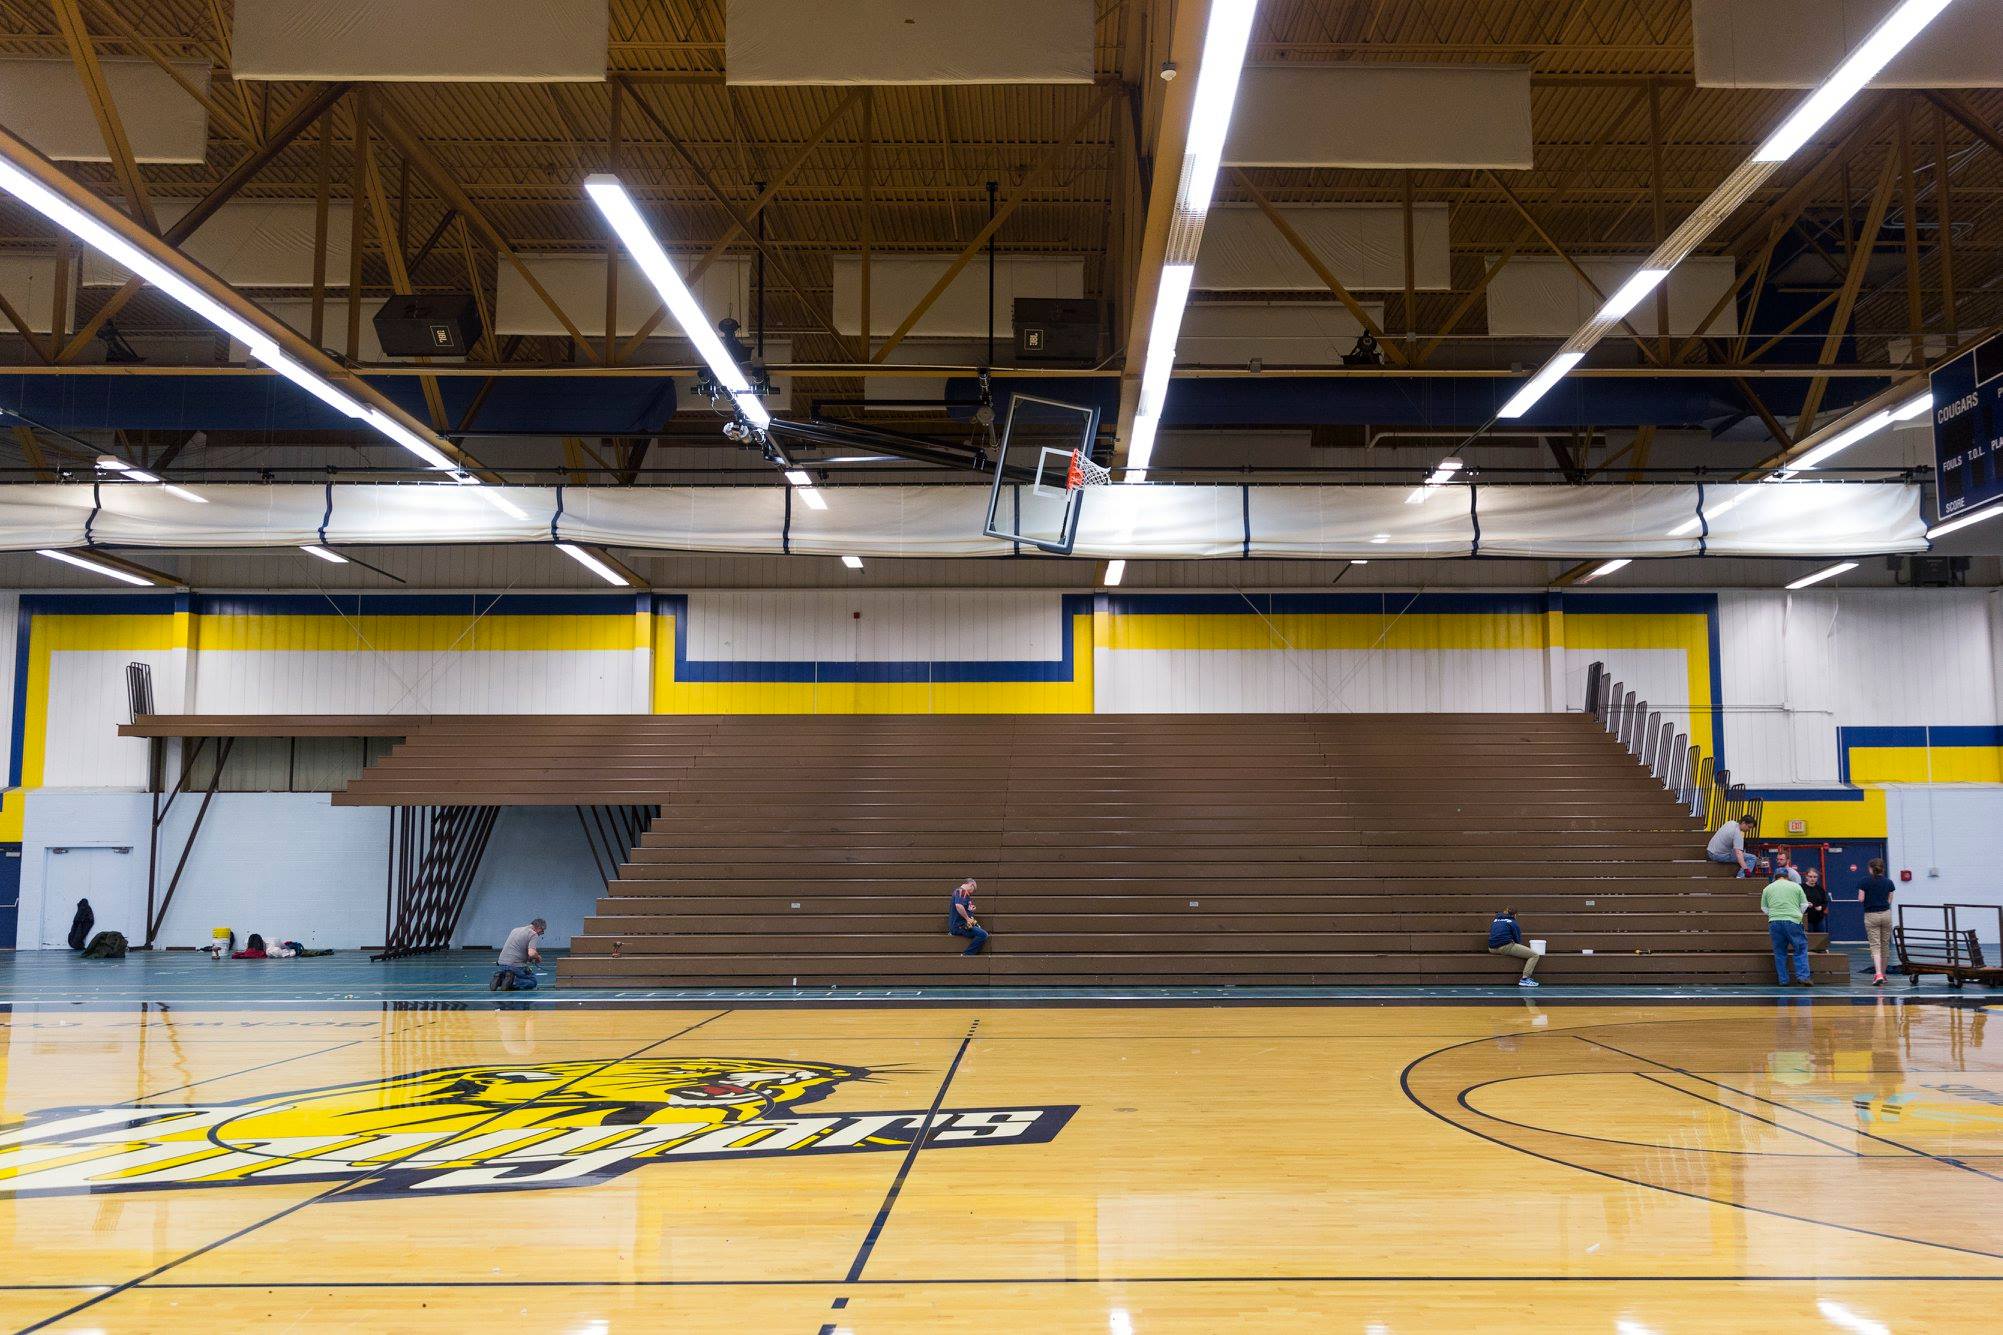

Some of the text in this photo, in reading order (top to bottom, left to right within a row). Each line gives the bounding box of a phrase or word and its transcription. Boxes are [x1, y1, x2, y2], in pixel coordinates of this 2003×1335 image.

[1937, 391, 1979, 425] COUGARS
[1942, 455, 1963, 473] FOULS
[1945, 496, 1965, 514] SCORE
